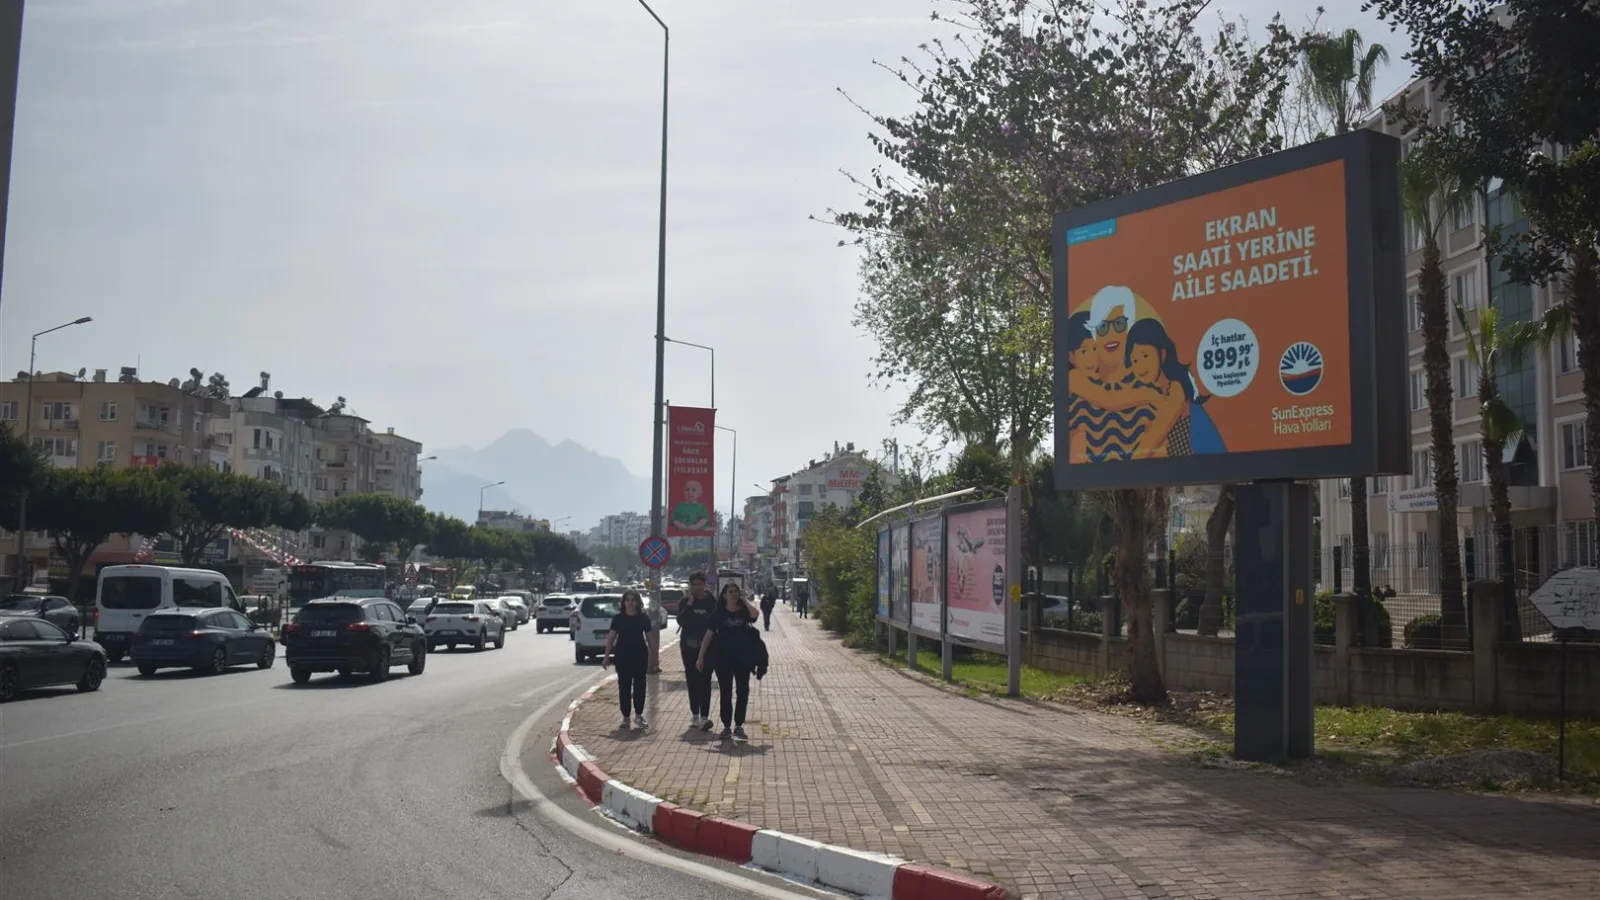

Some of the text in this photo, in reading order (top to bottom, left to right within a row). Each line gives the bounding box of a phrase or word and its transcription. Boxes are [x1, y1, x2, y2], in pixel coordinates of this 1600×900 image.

[1205, 206, 1276, 242] EKRAN
[1173, 225, 1316, 275] SAATİ YERİNE
[1171, 249, 1319, 302] AİLE SAADETİ.
[1220, 332, 1246, 344] hatlar
[1271, 404, 1334, 421] SunExpress
[1273, 420, 1299, 435] Hava
